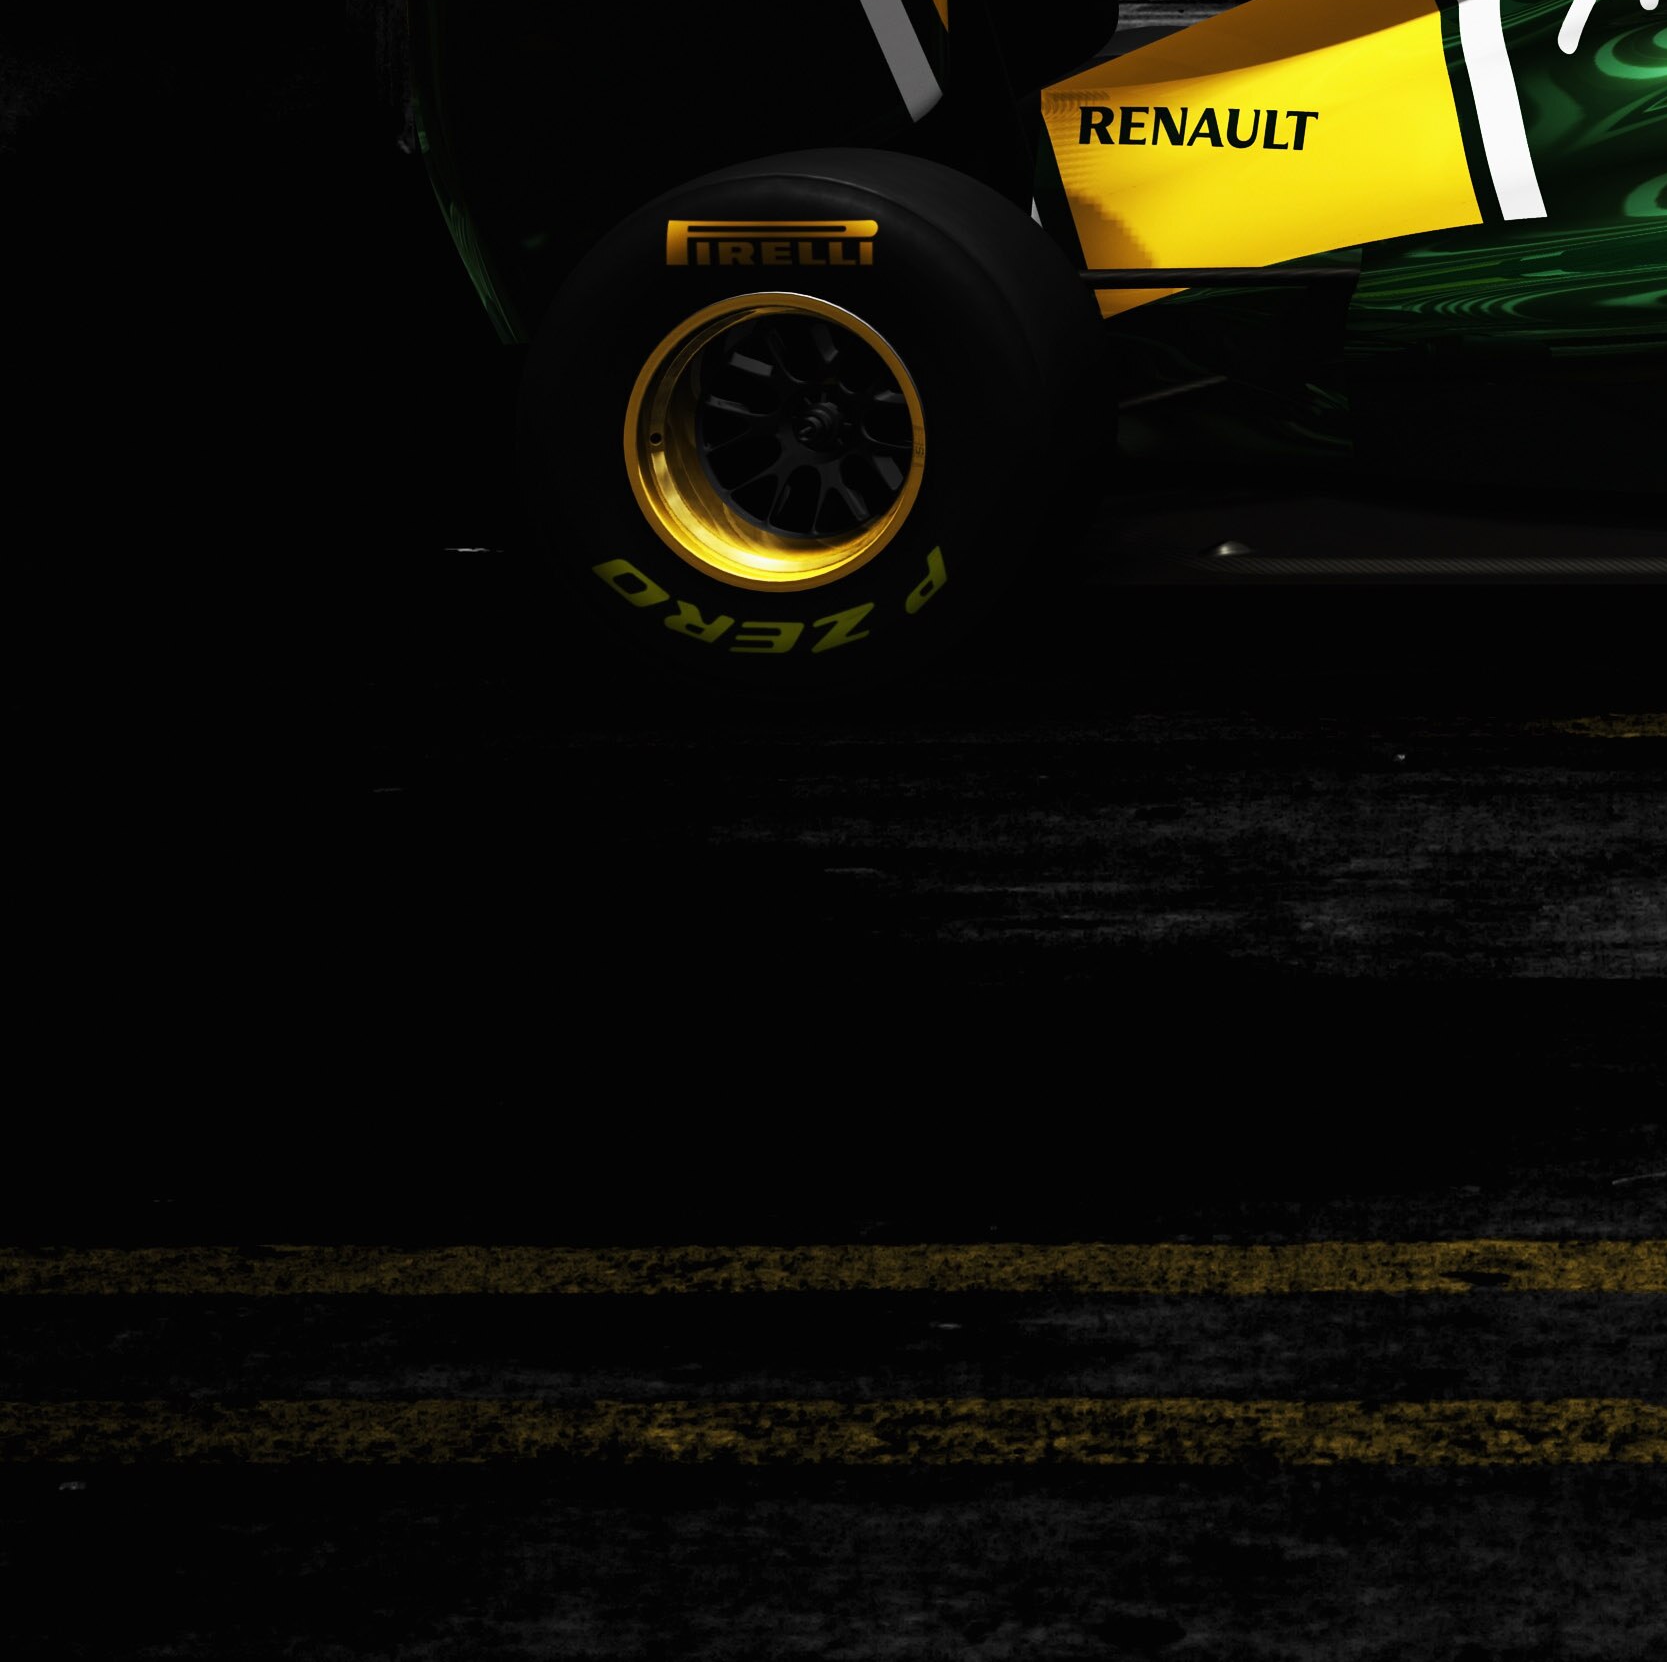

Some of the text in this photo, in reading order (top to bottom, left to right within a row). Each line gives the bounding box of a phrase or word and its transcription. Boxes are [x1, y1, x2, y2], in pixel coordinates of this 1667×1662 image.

[1078, 106, 1319, 151] RENAULT
[666, 219, 880, 266] PIRELLI
[591, 545, 948, 654] P ZERO
